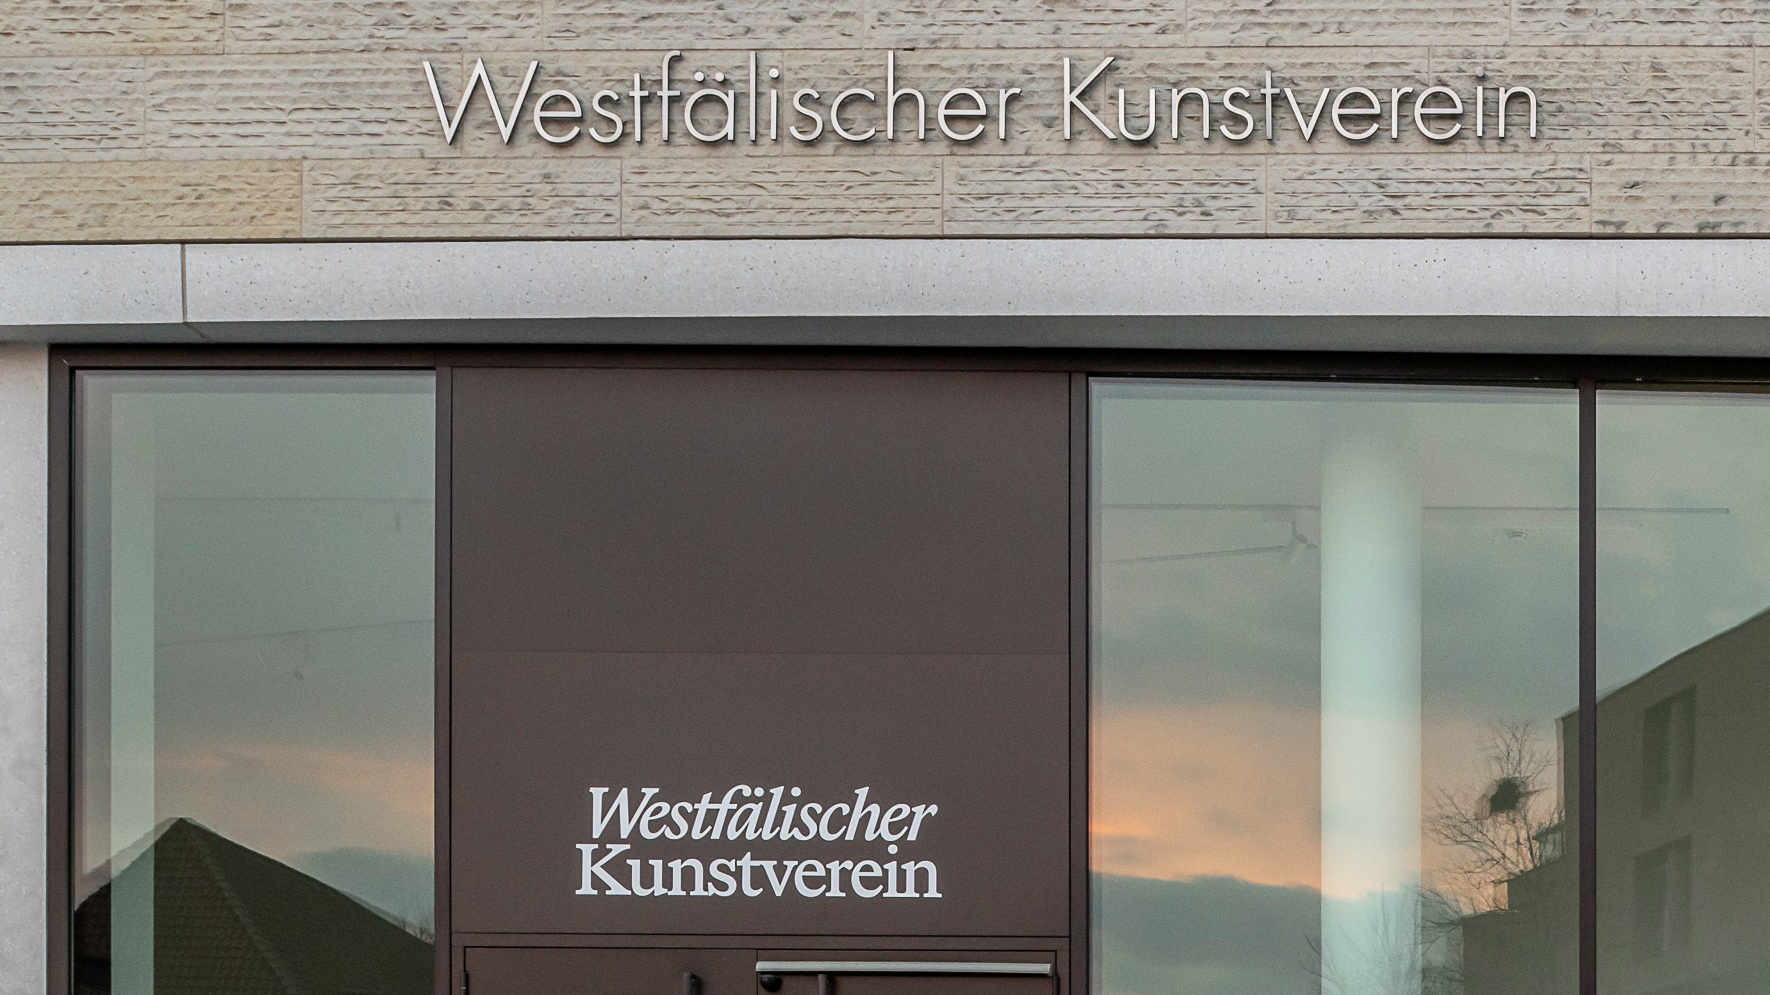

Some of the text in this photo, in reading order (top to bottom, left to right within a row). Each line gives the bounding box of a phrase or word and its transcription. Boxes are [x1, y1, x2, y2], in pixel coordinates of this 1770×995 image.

[422, 50, 1538, 147] Westfälischer Kunstverein
[589, 784, 938, 842] Westfälischer
[575, 843, 943, 898] Kunstverein
